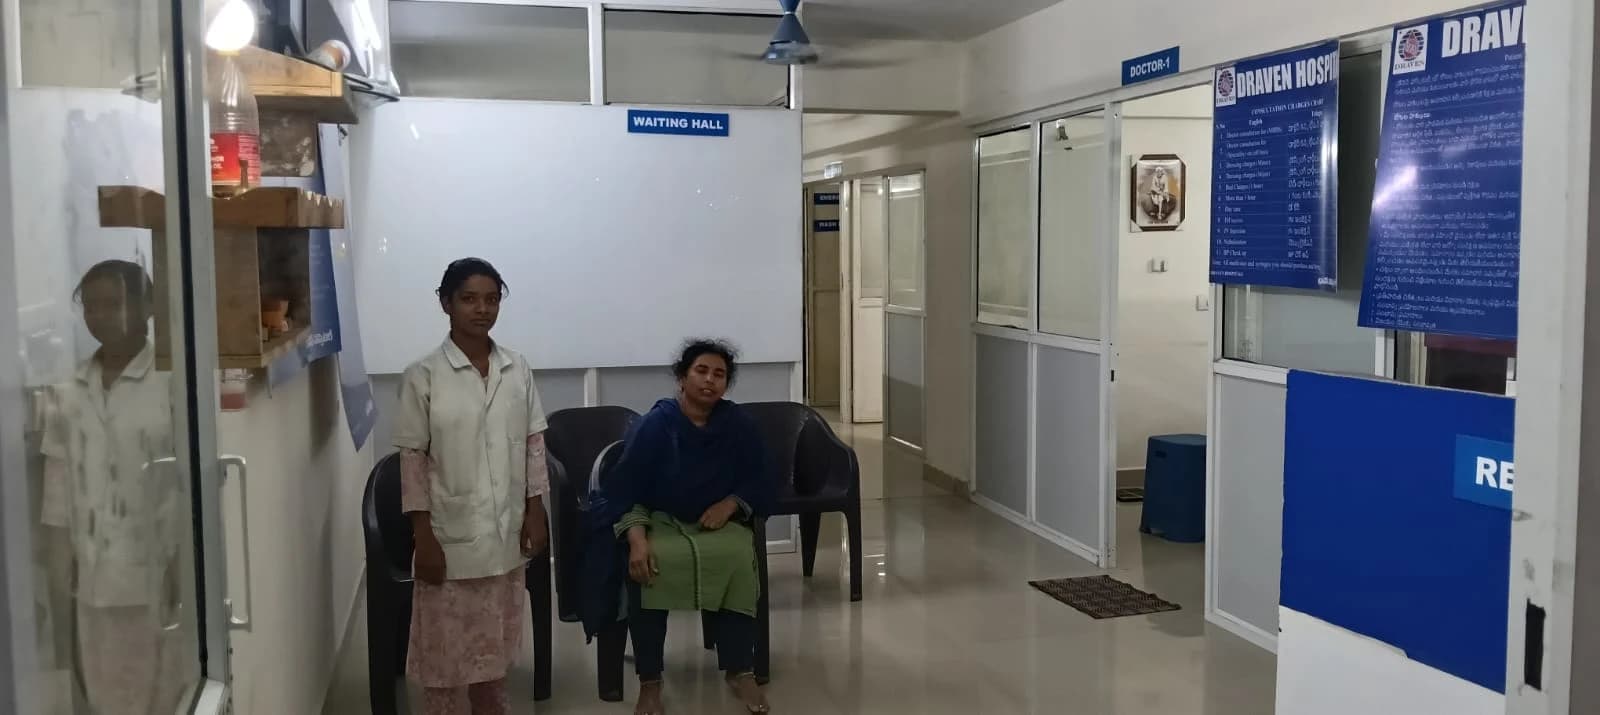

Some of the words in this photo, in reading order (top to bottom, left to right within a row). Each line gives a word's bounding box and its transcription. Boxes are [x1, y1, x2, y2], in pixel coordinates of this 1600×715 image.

[1130, 56, 1170, 78] DOCTOR-1
[1236, 63, 1293, 98] DRAVEN
[633, 116, 689, 128] WAITING
[691, 119, 724, 130] HALL
[1475, 456, 1514, 491] RE
